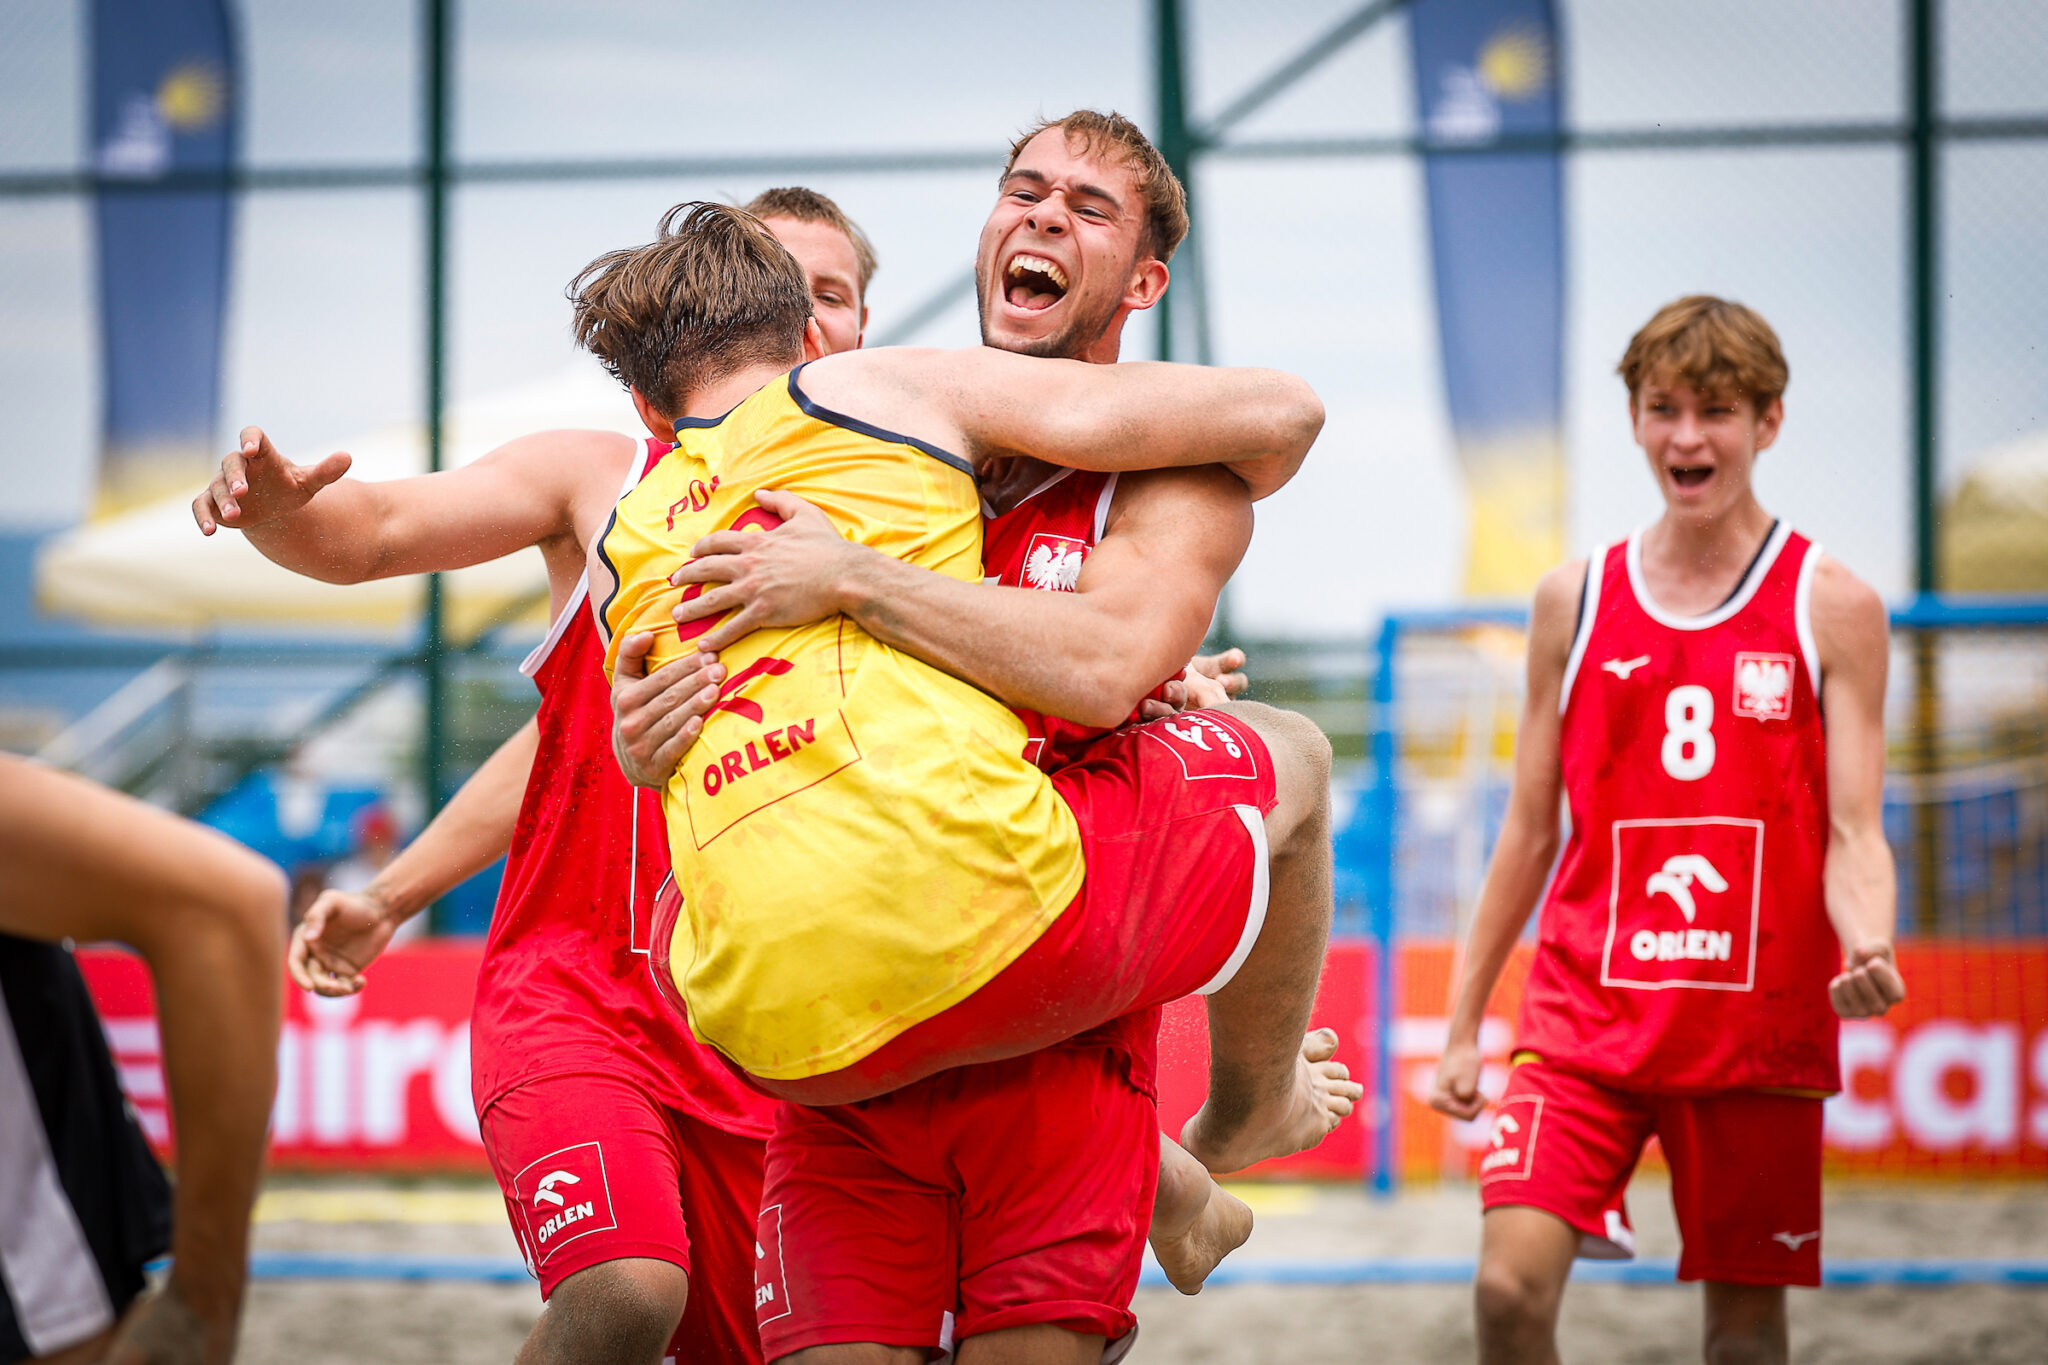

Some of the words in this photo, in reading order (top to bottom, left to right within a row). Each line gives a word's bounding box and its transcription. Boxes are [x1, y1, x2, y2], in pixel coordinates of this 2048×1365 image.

[704, 718, 816, 797] ORLEN
[1661, 684, 1717, 781] 8
[1630, 928, 1732, 961] ORLEN
[538, 1201, 594, 1244] ORLEN
